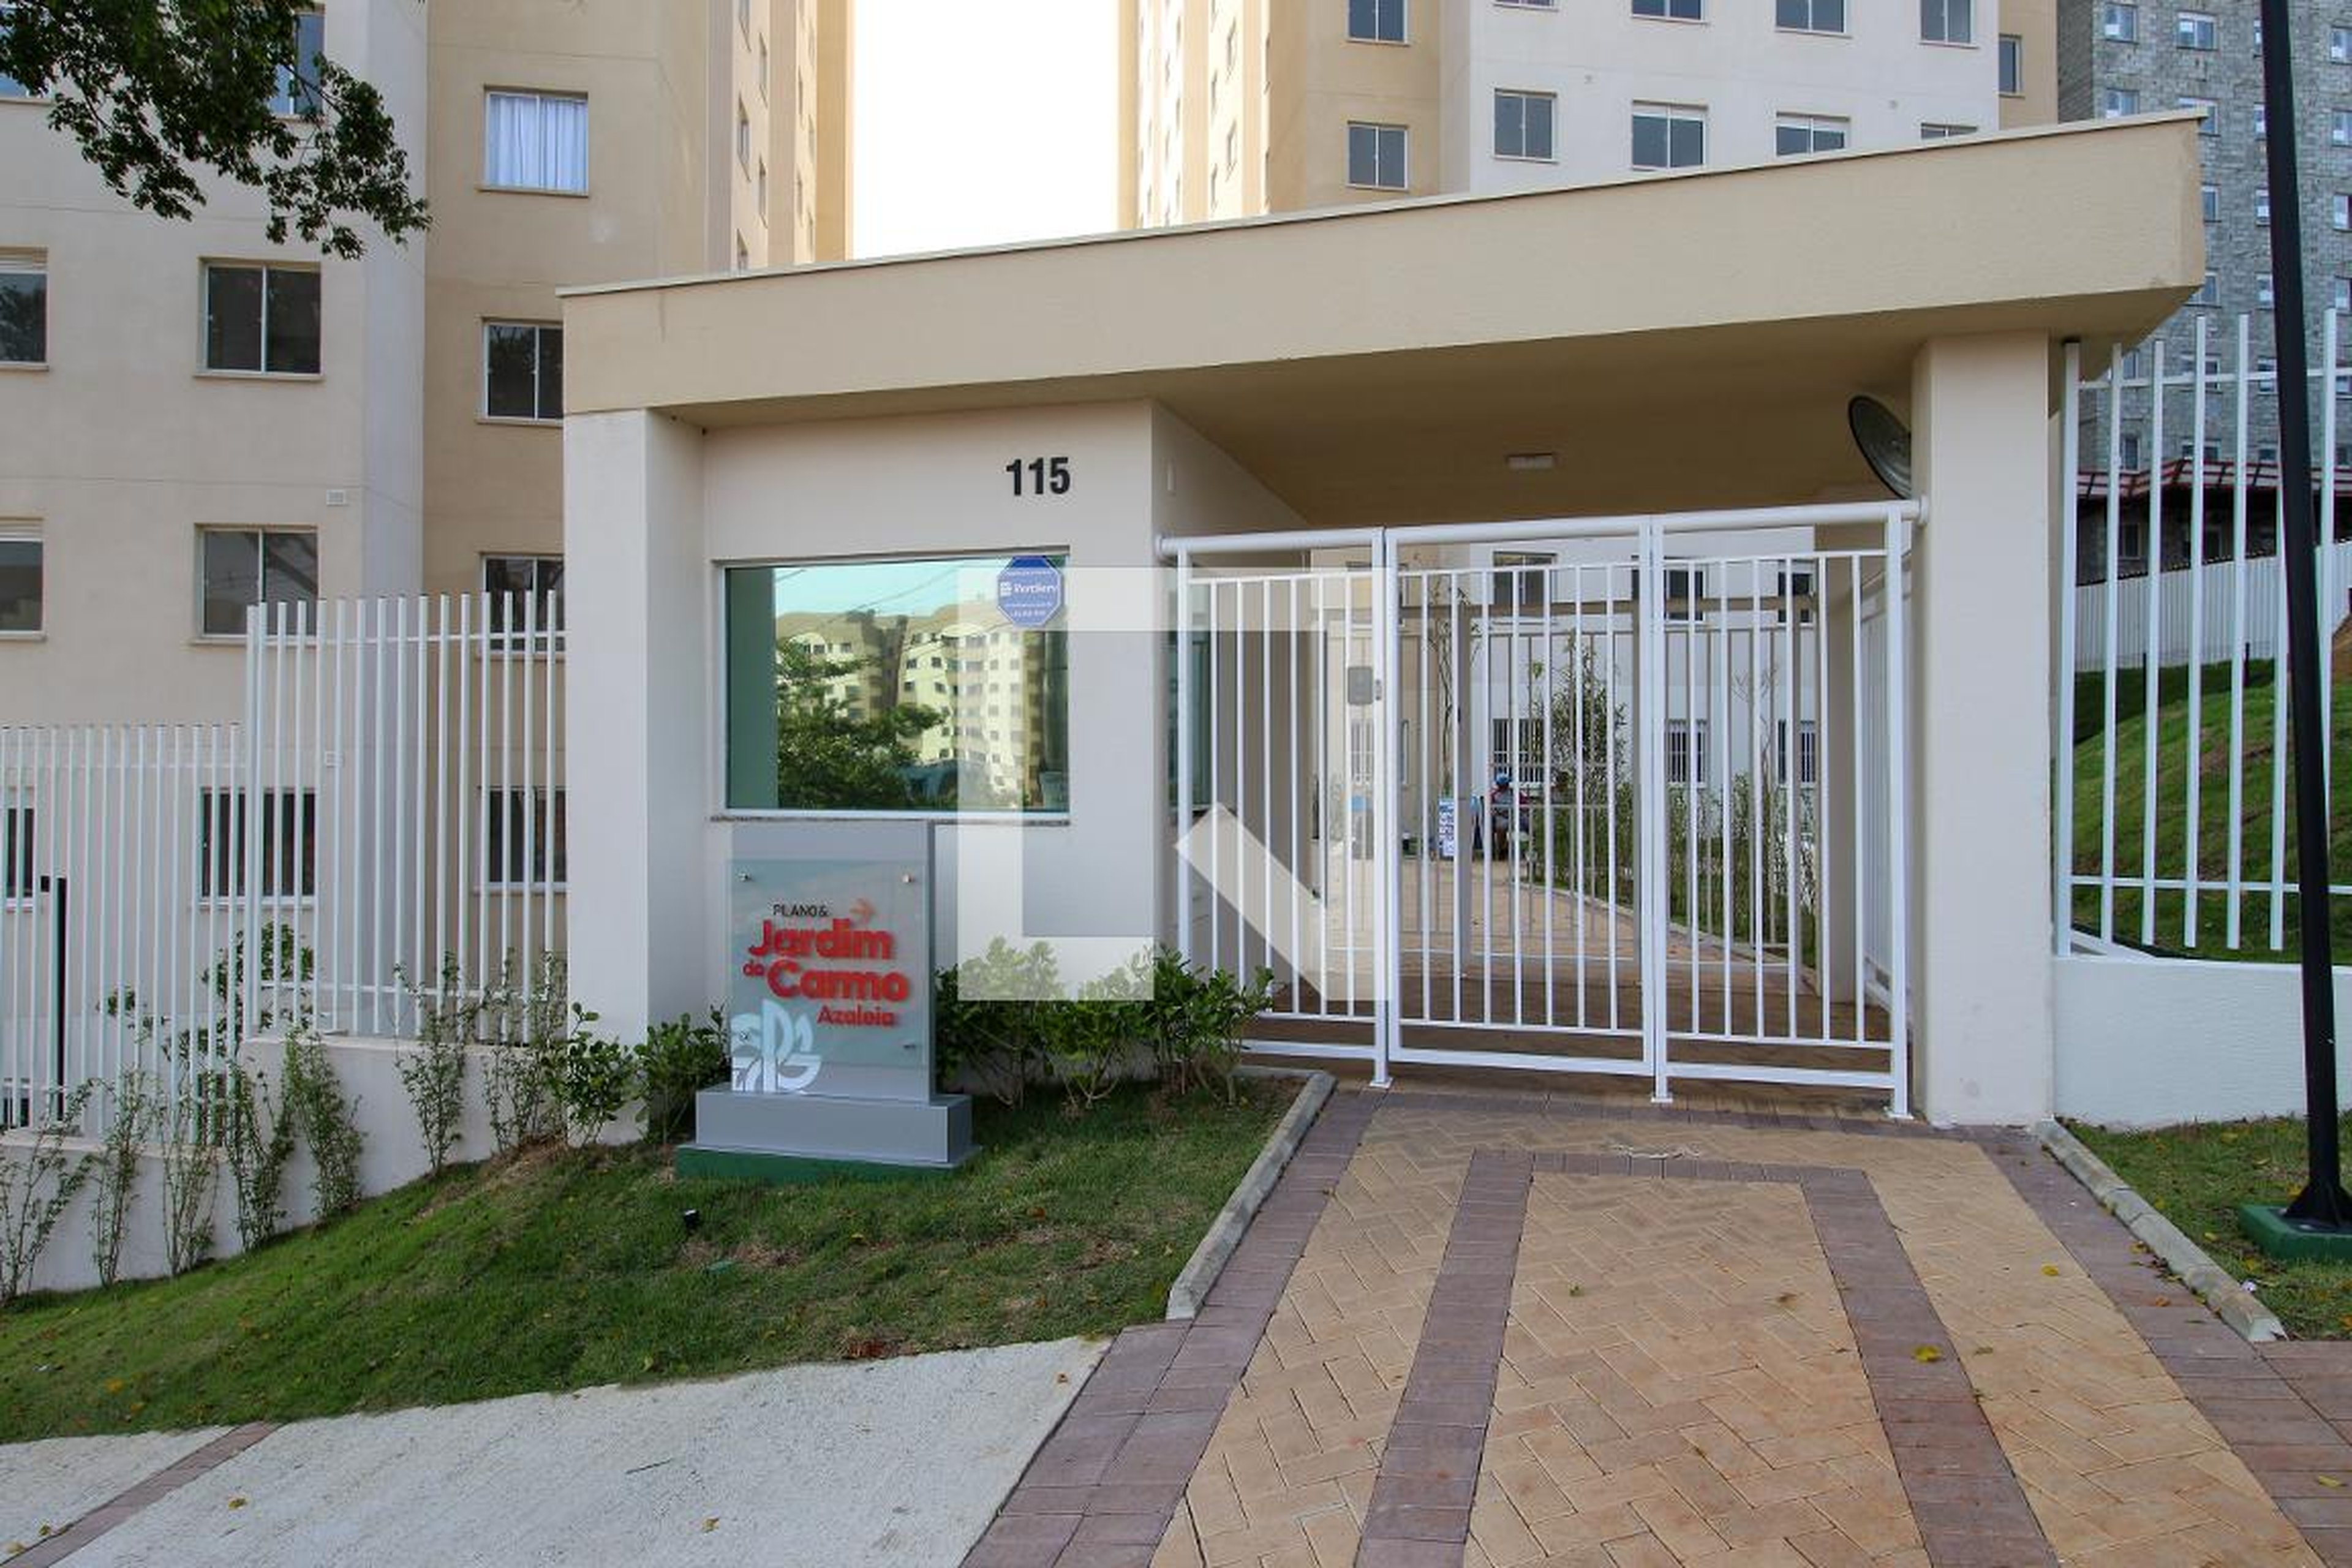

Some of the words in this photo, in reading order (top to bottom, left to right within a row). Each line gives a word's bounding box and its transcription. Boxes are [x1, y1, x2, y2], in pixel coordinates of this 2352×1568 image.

[1005, 457, 1071, 496] 115
[748, 918, 895, 960] Jardim
[742, 959, 764, 977] do
[767, 959, 910, 1002] Carmo
[817, 1005, 898, 1027] Azaleia
